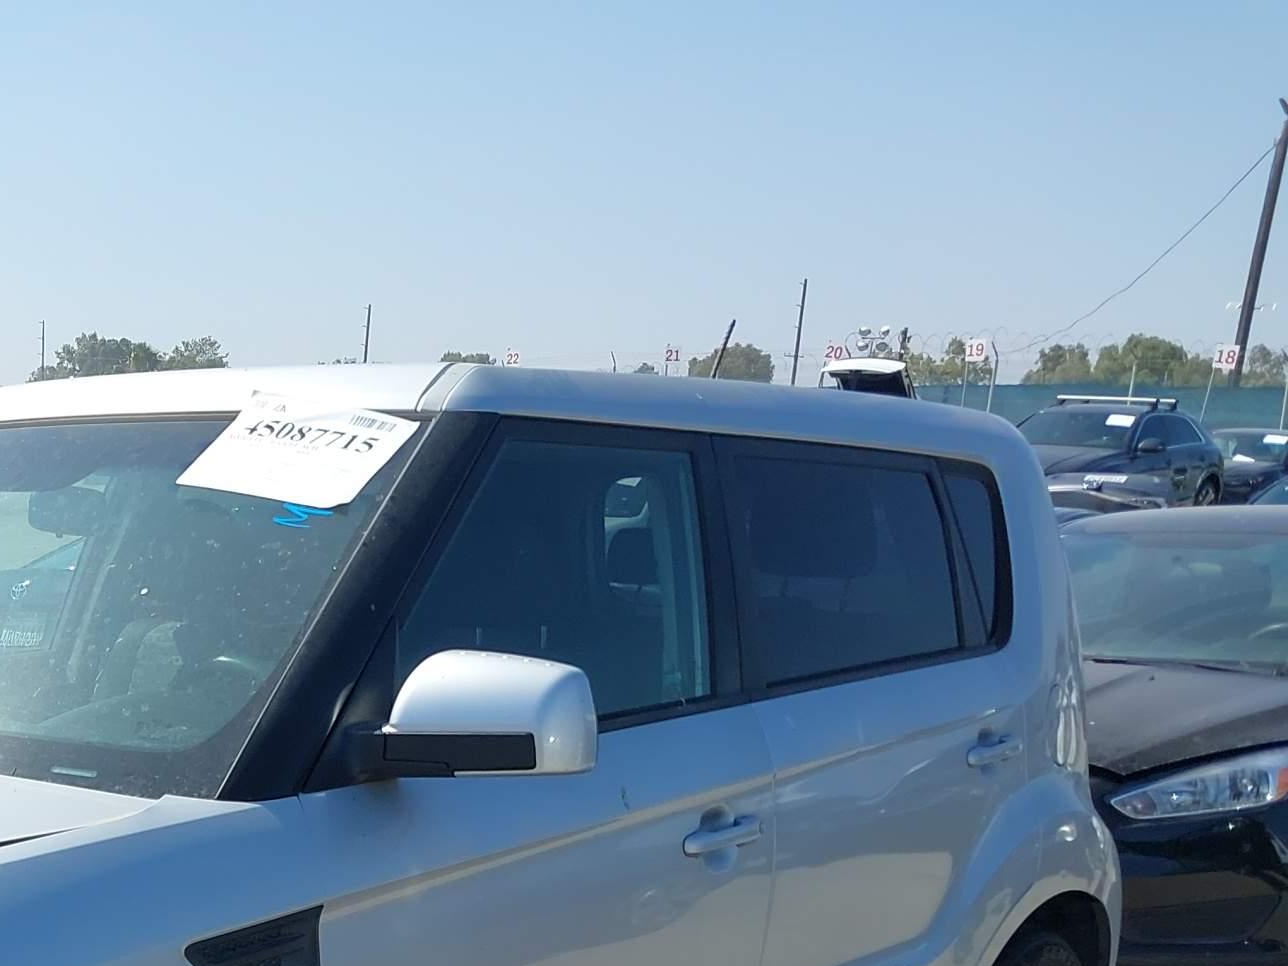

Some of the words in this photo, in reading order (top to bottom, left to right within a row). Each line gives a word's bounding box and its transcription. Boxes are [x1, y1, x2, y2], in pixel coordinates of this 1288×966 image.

[665, 350, 680, 362] 21
[825, 345, 844, 360] 20
[966, 343, 985, 357] 19
[1214, 349, 1237, 364] 18
[506, 353, 520, 364] 22
[244, 420, 381, 453] 45087715
